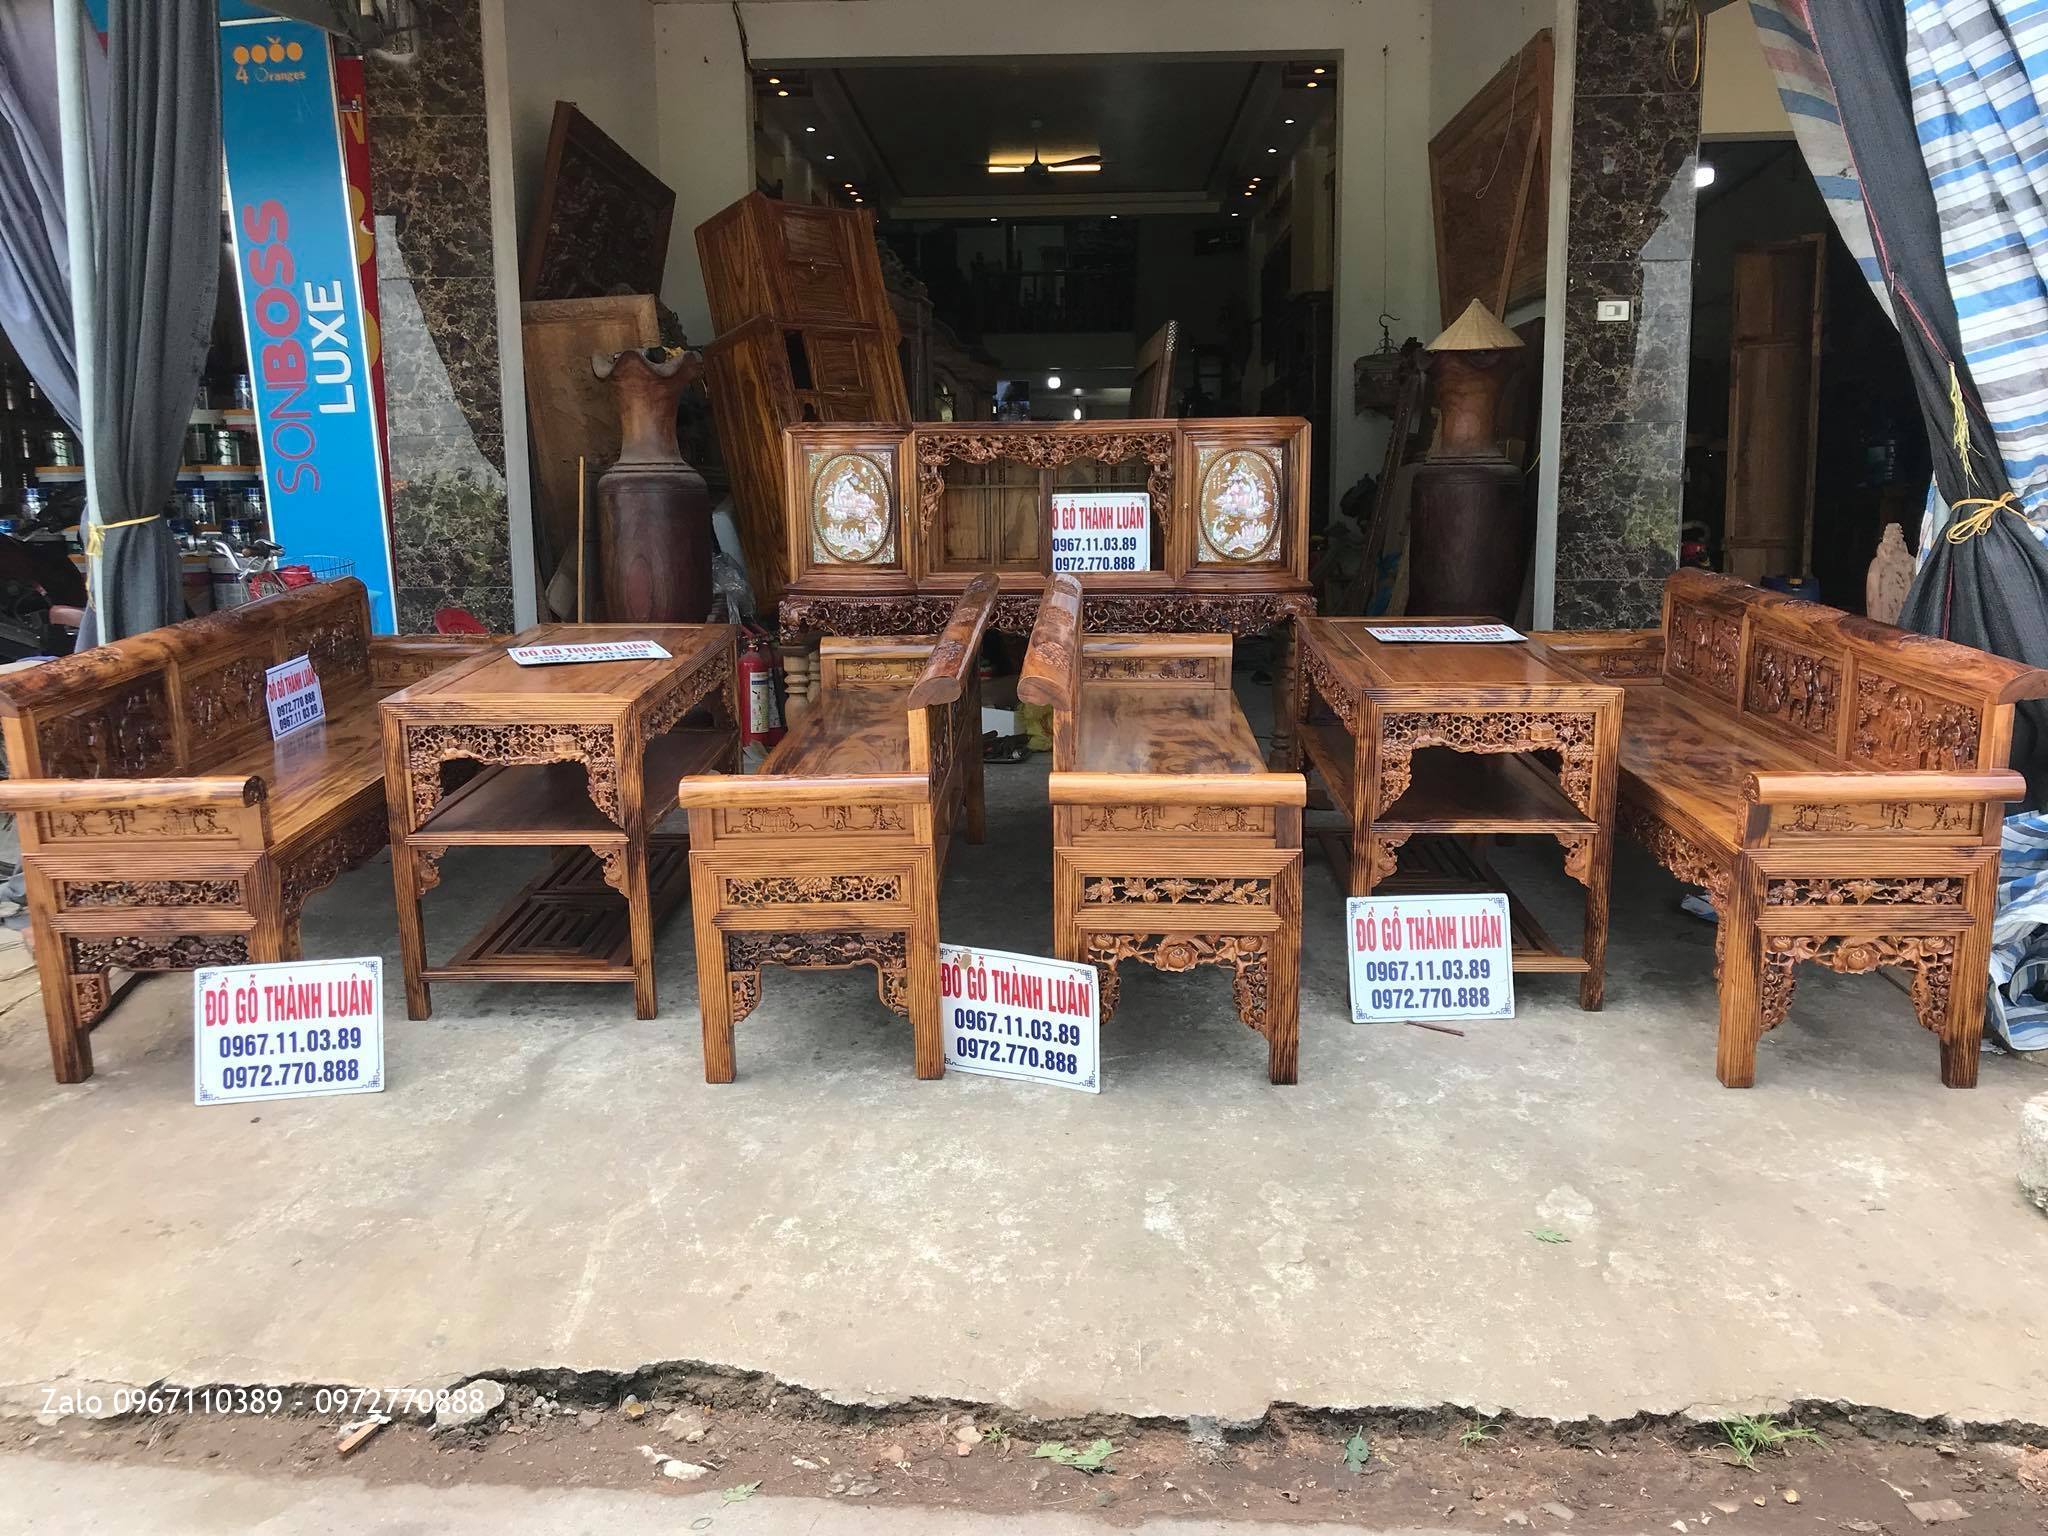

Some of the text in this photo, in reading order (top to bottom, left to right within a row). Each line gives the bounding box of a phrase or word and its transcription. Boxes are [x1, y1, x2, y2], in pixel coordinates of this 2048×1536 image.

[235, 66, 306, 84] 4 Oranges
[243, 199, 321, 493] SONBOSS
[304, 280, 356, 414] LUXE
[1062, 499, 1076, 530] GỖ
[1079, 502, 1114, 530] THÀNH
[1116, 502, 1144, 529] LUÂN
[1053, 537, 1137, 552] 0967.11.03.89
[1055, 557, 1135, 571] 0972.770.888
[1356, 906, 1502, 952] ĐỒ GỖ THÀNH LUÂN
[1366, 959, 1491, 982] 0967.11.03.89
[205, 973, 373, 1026] ĐỒ GỖ THÀNH LUÂN
[967, 956, 988, 1002] GỖ
[991, 966, 1043, 1010] THÀNH
[1048, 974, 1090, 1018] LUÂN
[1371, 987, 1490, 1009] 0972.770.888
[219, 1027, 362, 1058] 0967.11.03.89
[954, 1008, 1080, 1046] 0967.11.03.89
[957, 1036, 1077, 1074] 0972.770.888
[222, 1059, 359, 1089] 0972.770.888
